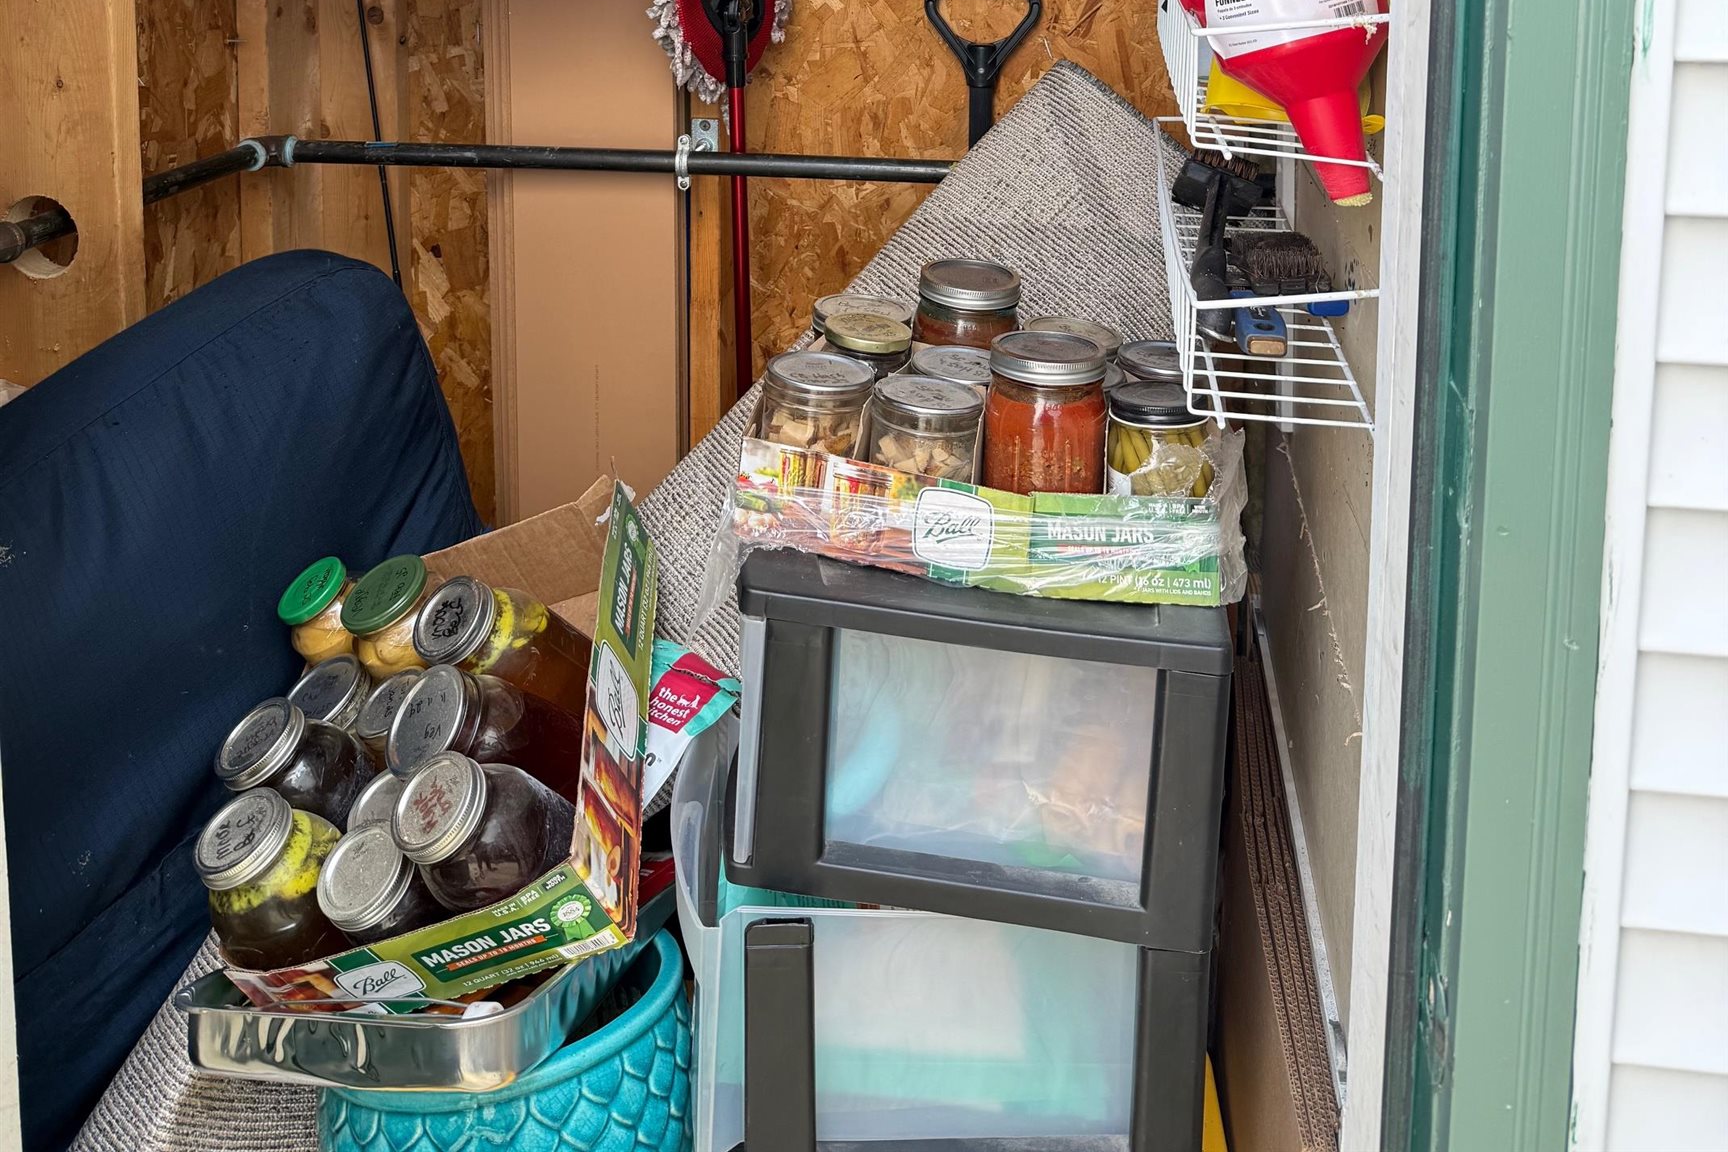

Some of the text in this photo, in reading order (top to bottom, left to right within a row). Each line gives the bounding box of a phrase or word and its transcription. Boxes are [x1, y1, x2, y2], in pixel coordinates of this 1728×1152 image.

[923, 511, 982, 544] Ball
[1048, 522, 1155, 544] MASON JARS
[621, 545, 633, 585] JARS
[1151, 577, 1165, 587] oz
[1173, 578, 1191, 588] 473
[1193, 578, 1212, 589] ml)
[614, 577, 629, 635] MASON
[608, 659, 627, 740] Ball
[659, 687, 678, 703] the
[648, 708, 683, 727] itchen
[650, 696, 691, 719] honest
[520, 890, 537, 901] BPA
[524, 894, 540, 905] FREE
[495, 907, 519, 917] U.S.A.
[421, 935, 498, 968] MASON
[499, 917, 552, 944] JARS
[455, 957, 477, 968] SEALS
[509, 938, 537, 952] MONTHS
[353, 968, 405, 996] Ball
[474, 972, 500, 984] QUART
